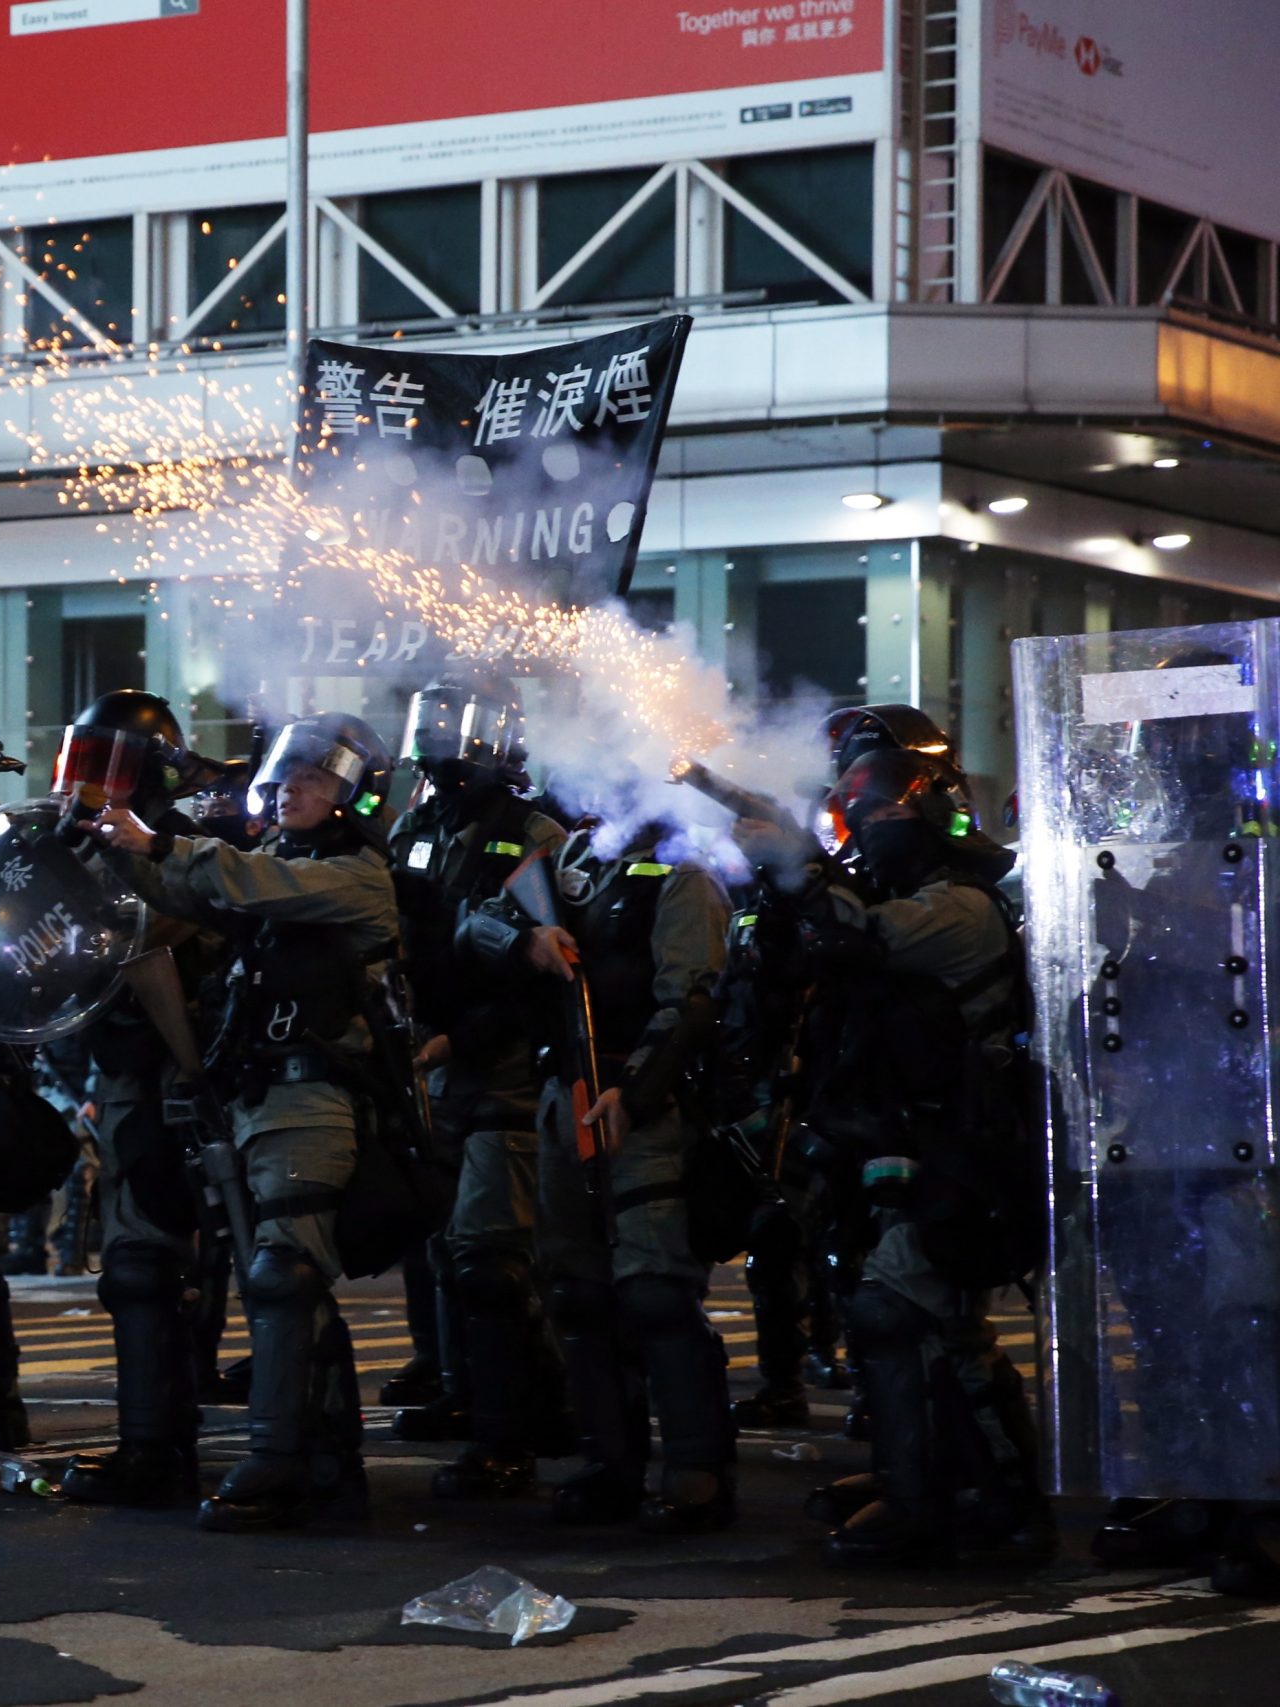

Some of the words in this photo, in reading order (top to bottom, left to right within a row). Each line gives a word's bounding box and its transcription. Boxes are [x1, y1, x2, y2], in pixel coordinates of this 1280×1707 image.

[22, 13, 48, 26] Easy
[53, 9, 89, 21] Invest
[677, 7, 760, 35] Together
[765, 4, 794, 22] we
[314, 360, 425, 440] 警告
[473, 346, 652, 447] 催淚煙
[364, 502, 594, 565] WARNING
[297, 619, 428, 663] TEAR
[8, 901, 81, 977] POLICE
